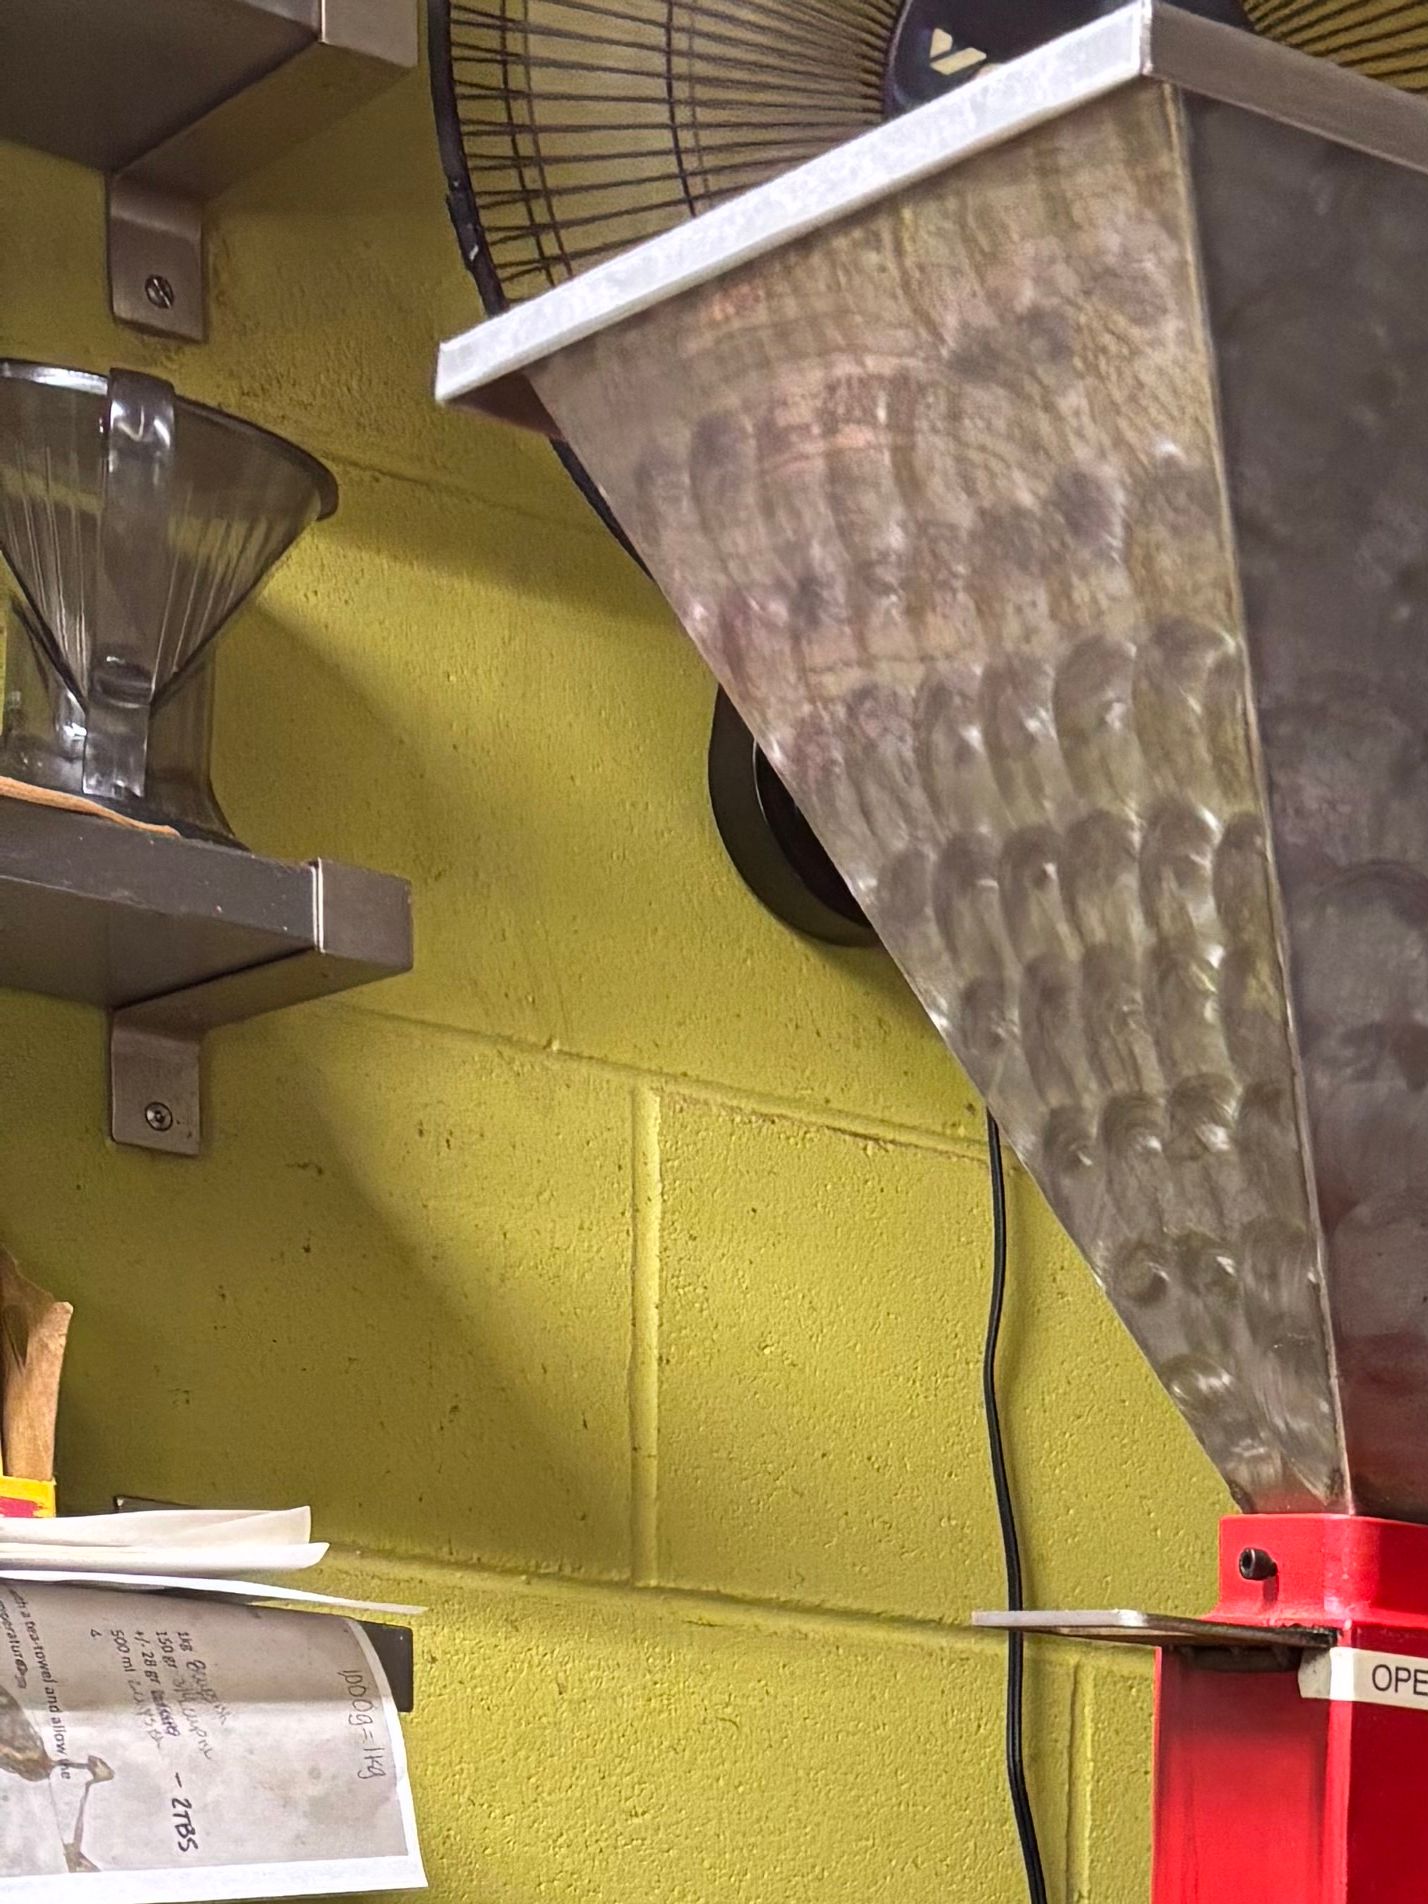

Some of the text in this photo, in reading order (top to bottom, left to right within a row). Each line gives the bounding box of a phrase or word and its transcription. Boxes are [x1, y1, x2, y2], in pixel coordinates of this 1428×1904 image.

[110, 1629, 130, 1654] 500
[156, 1631, 174, 1653] 150
[142, 1651, 157, 1667] 28
[45, 1687, 63, 1713] and
